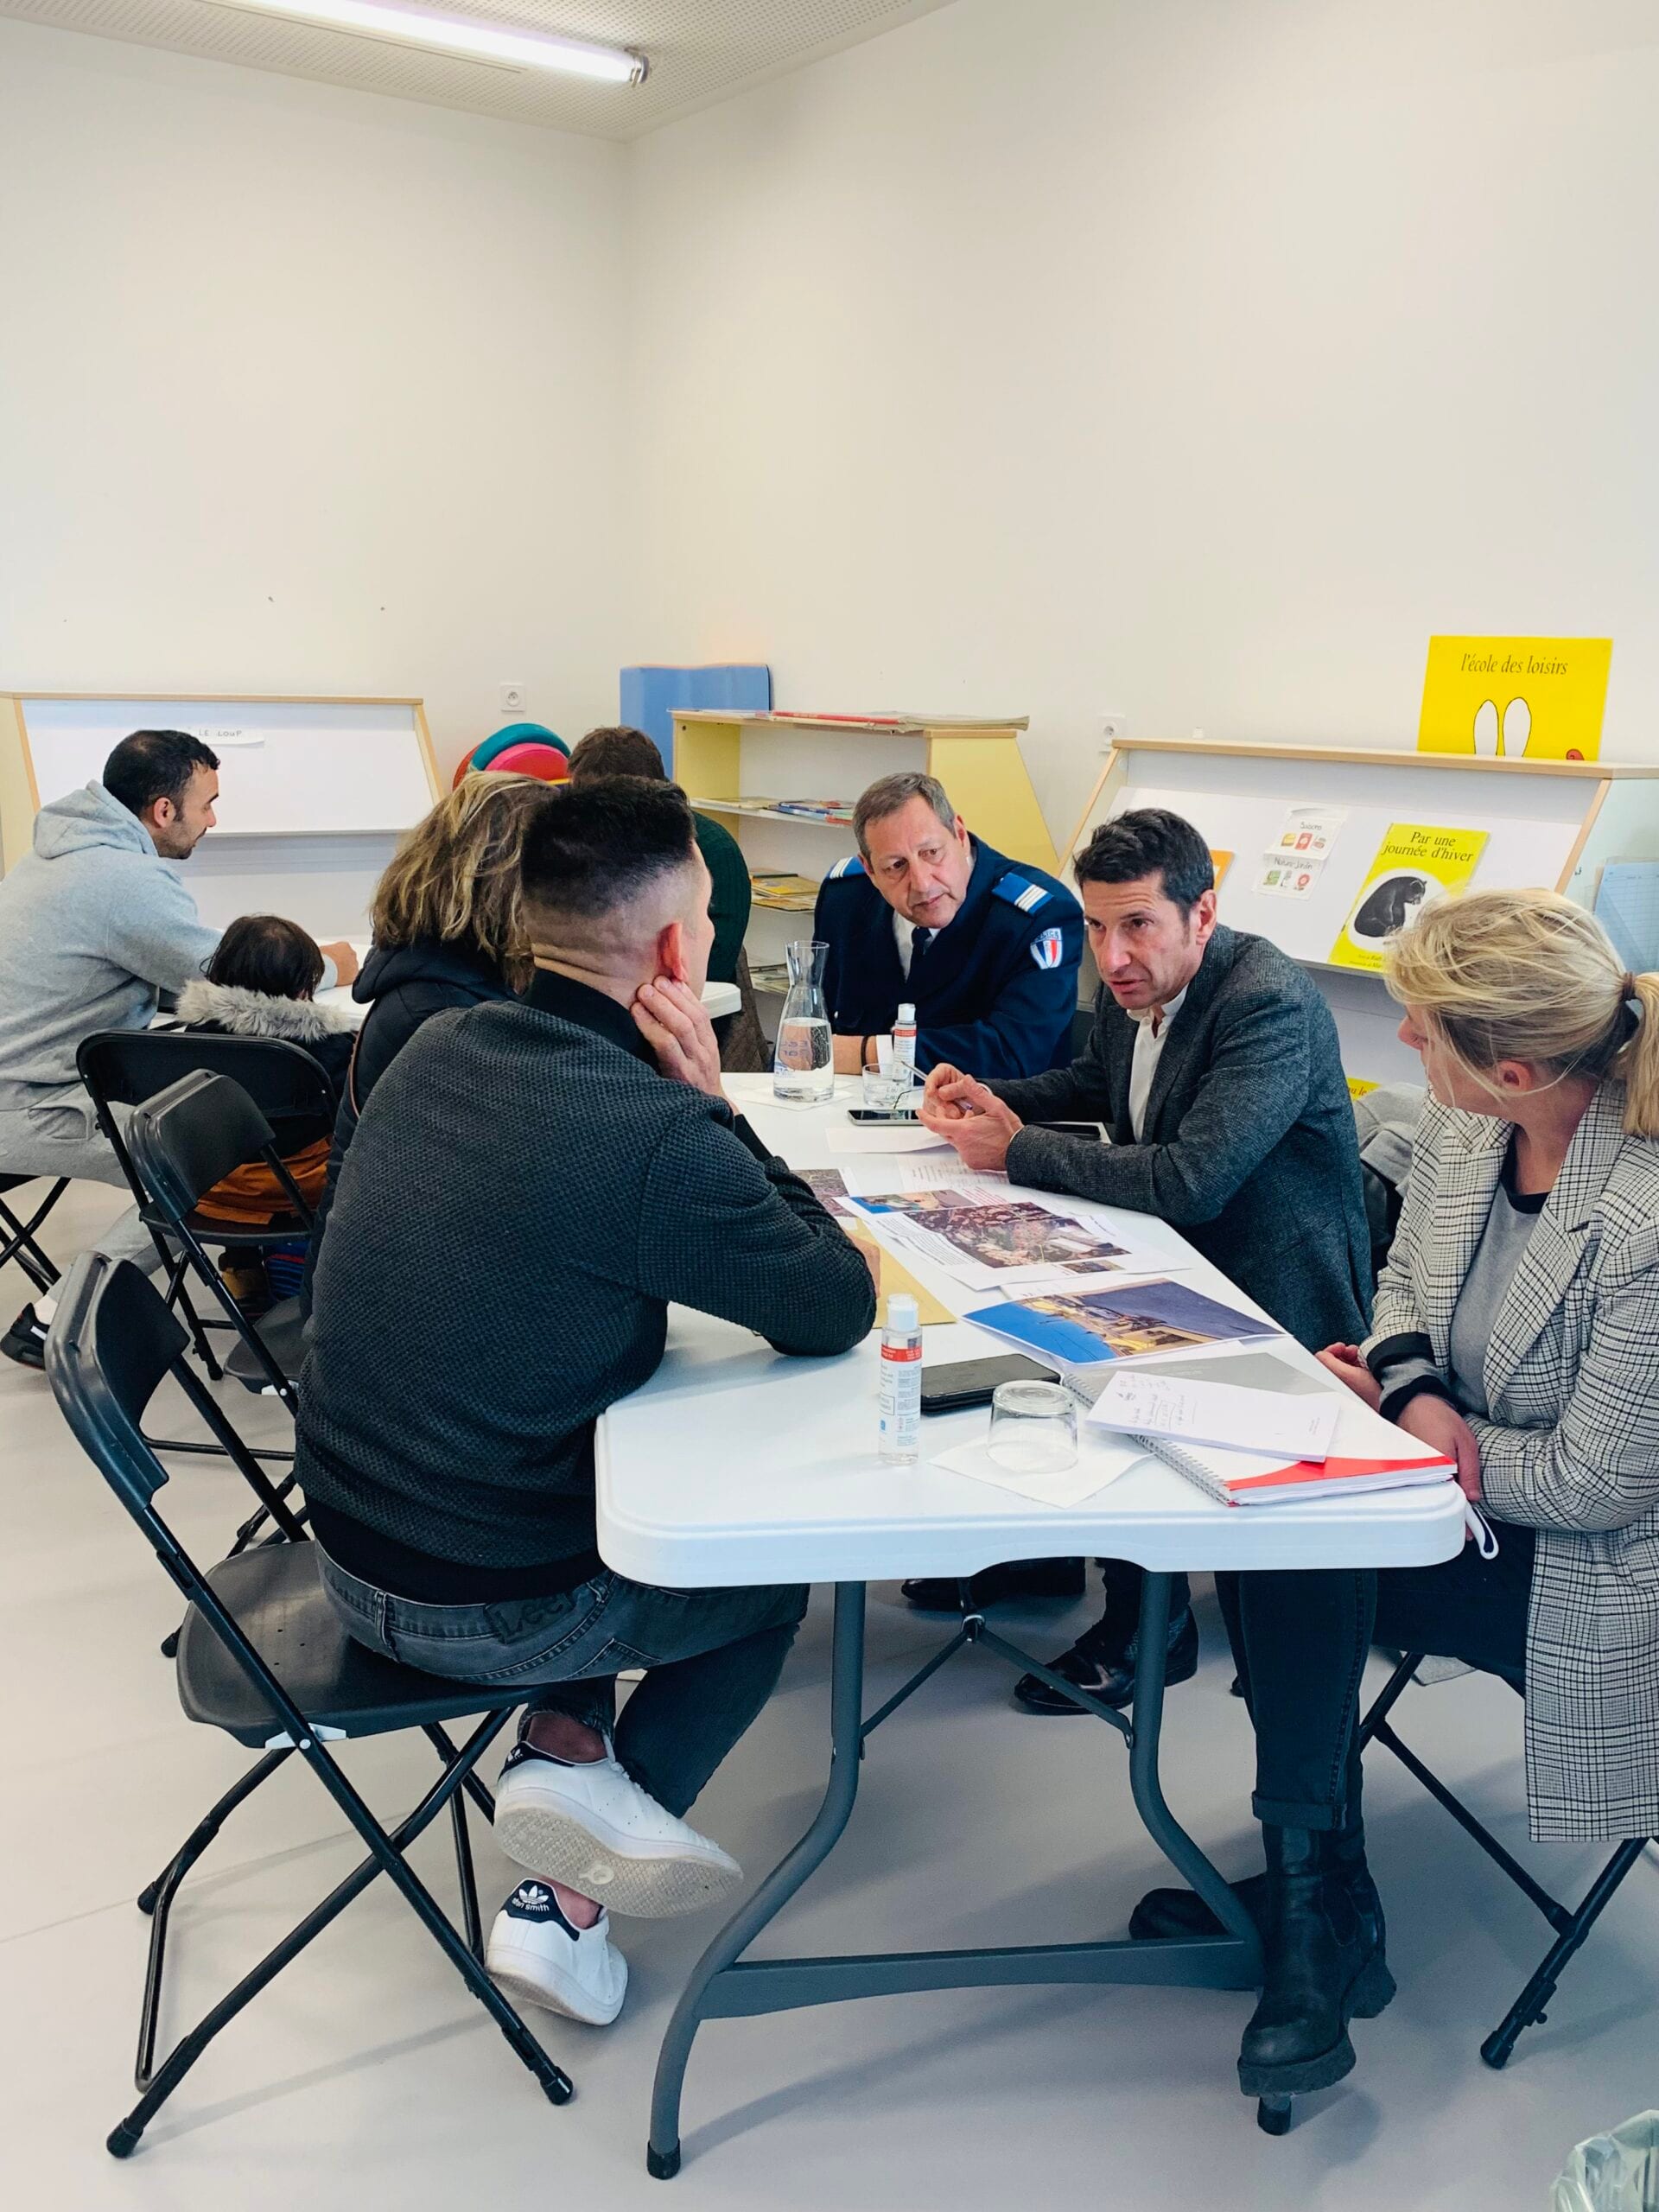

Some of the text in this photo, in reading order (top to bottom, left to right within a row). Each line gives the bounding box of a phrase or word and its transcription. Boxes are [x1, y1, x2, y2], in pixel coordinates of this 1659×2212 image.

[1461, 653, 1568, 675] l'école des loisirs
[199, 728, 209, 737] LE
[1410, 831, 1456, 847] Par une
[1382, 842, 1474, 862] journée d'hiver
